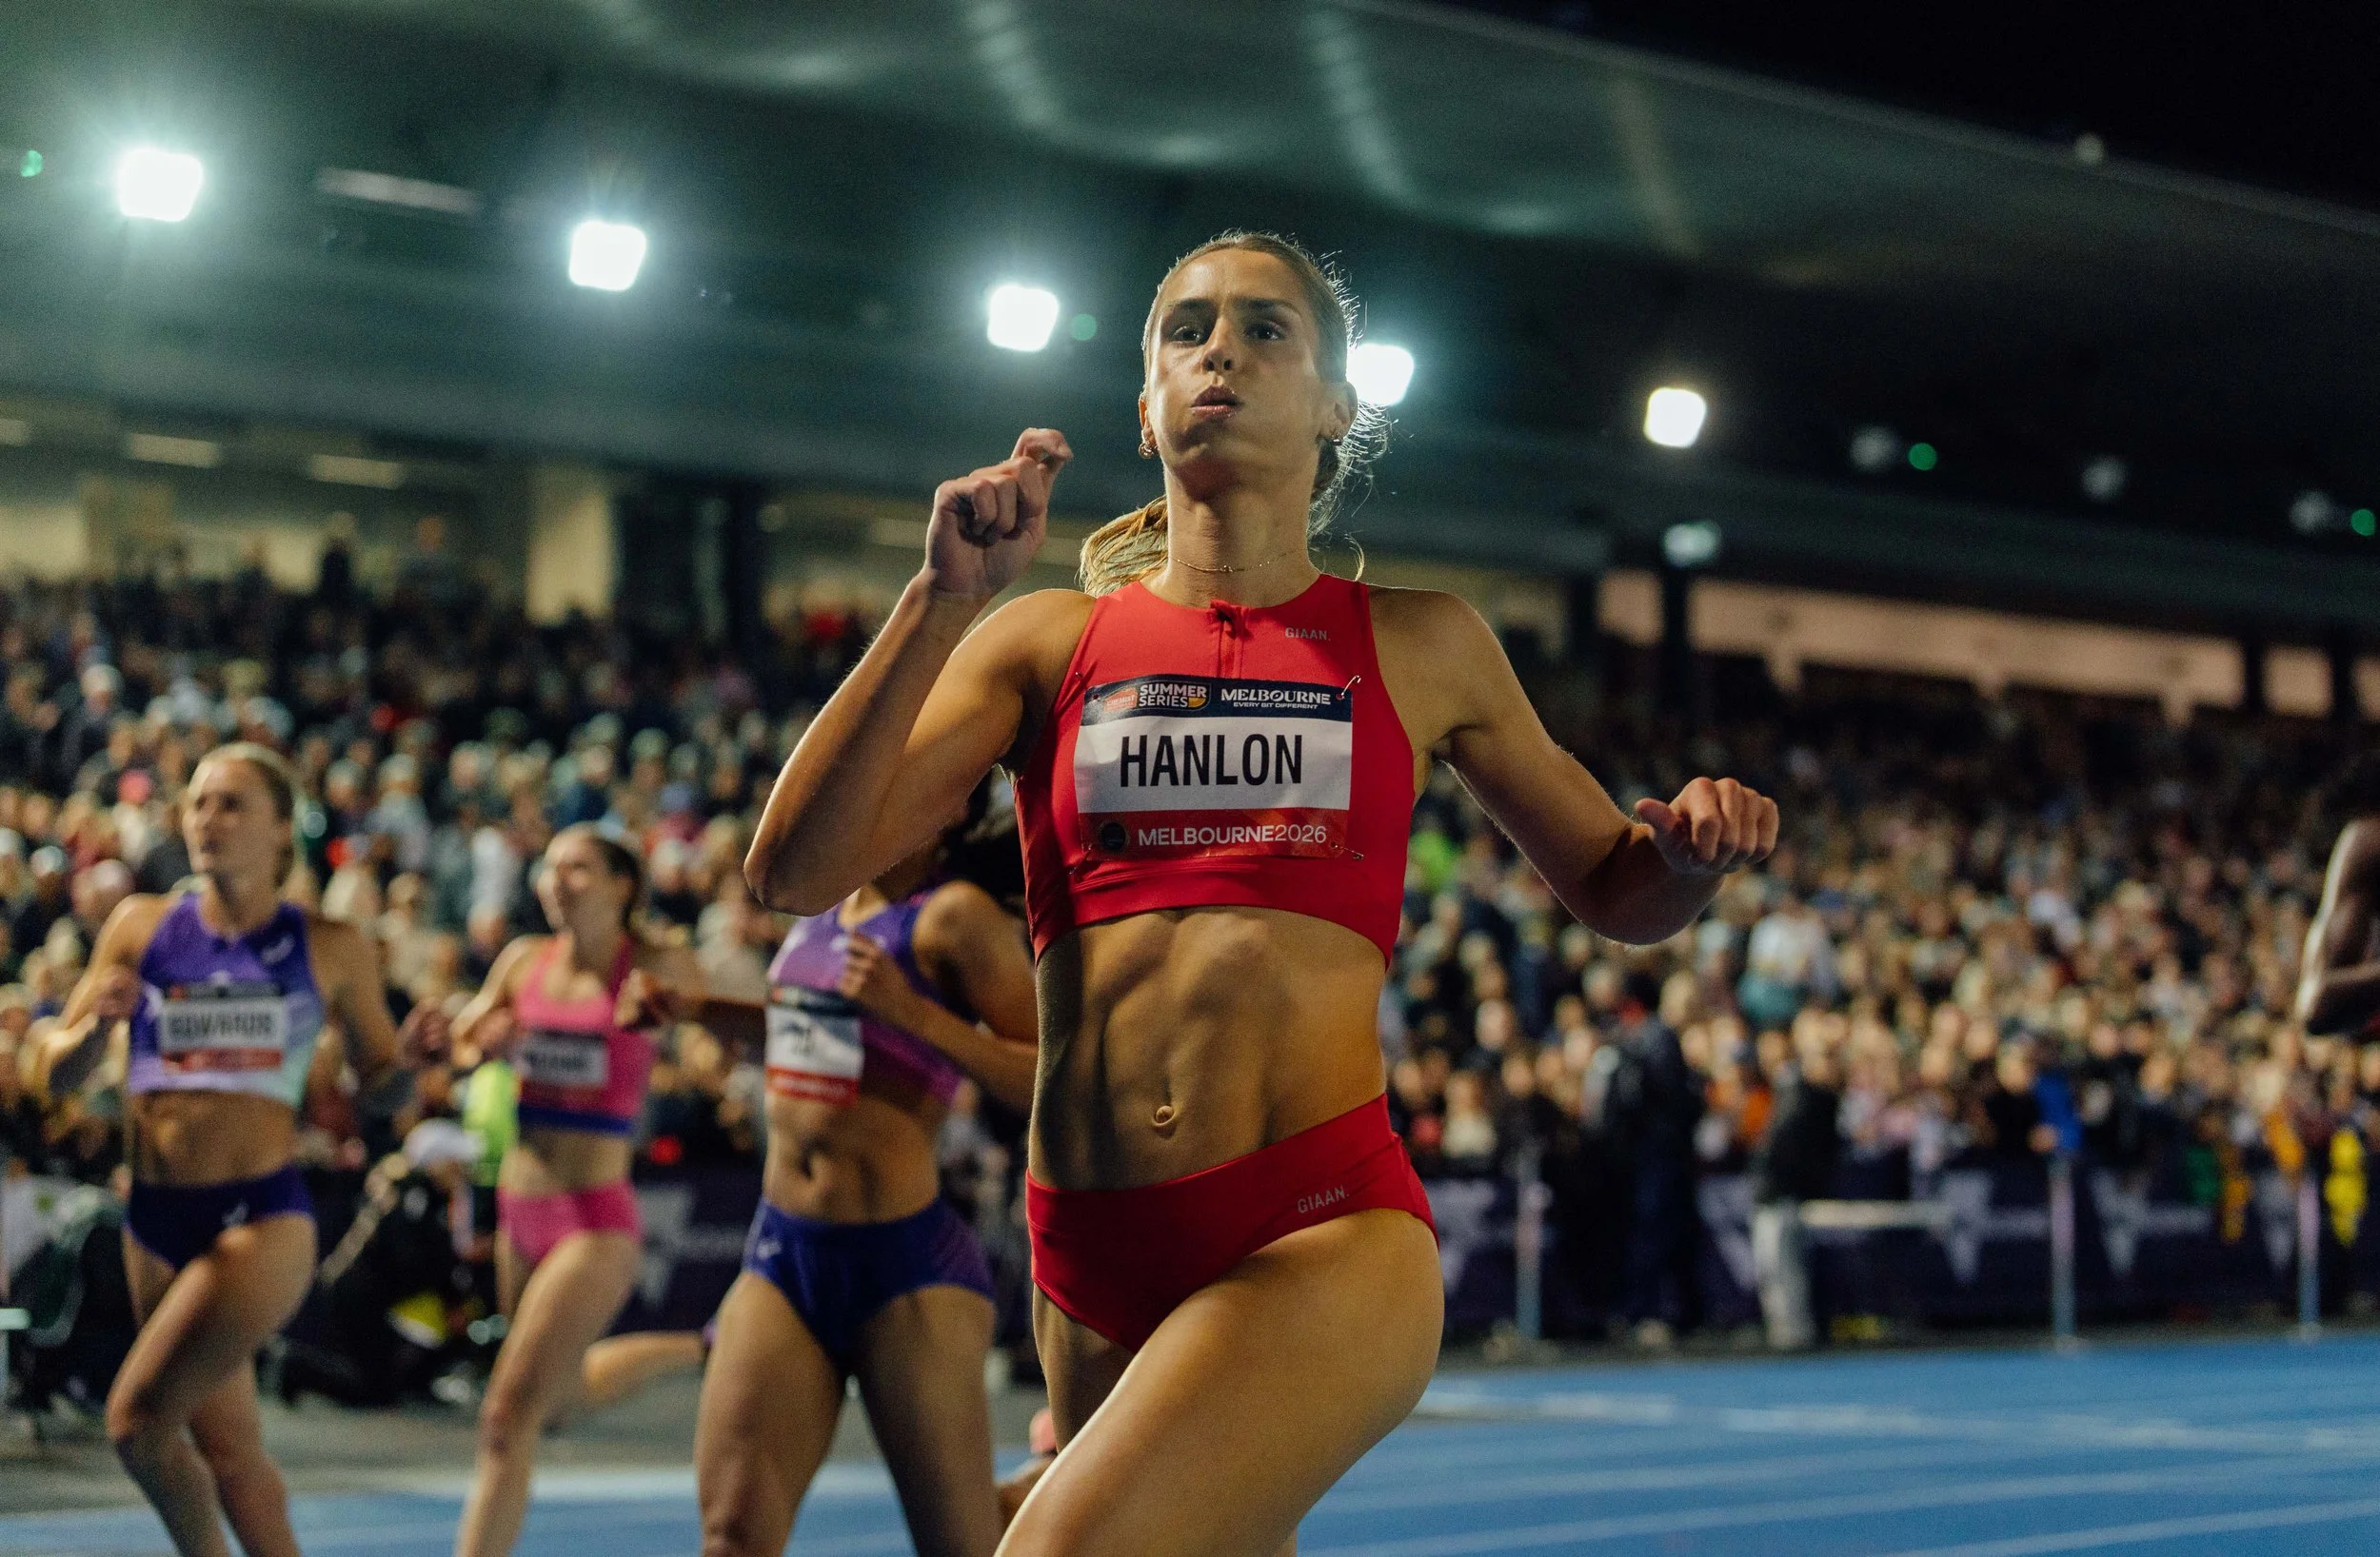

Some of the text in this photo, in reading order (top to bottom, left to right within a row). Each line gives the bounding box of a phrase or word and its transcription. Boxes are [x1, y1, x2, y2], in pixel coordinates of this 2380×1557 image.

[1139, 683, 1207, 698] SUMMER
[1220, 688, 1331, 705] MELBOURNE
[1139, 696, 1188, 707] SERIES
[1121, 734, 1302, 788] HANLON
[1138, 824, 1327, 846] MELBOURNE2026
